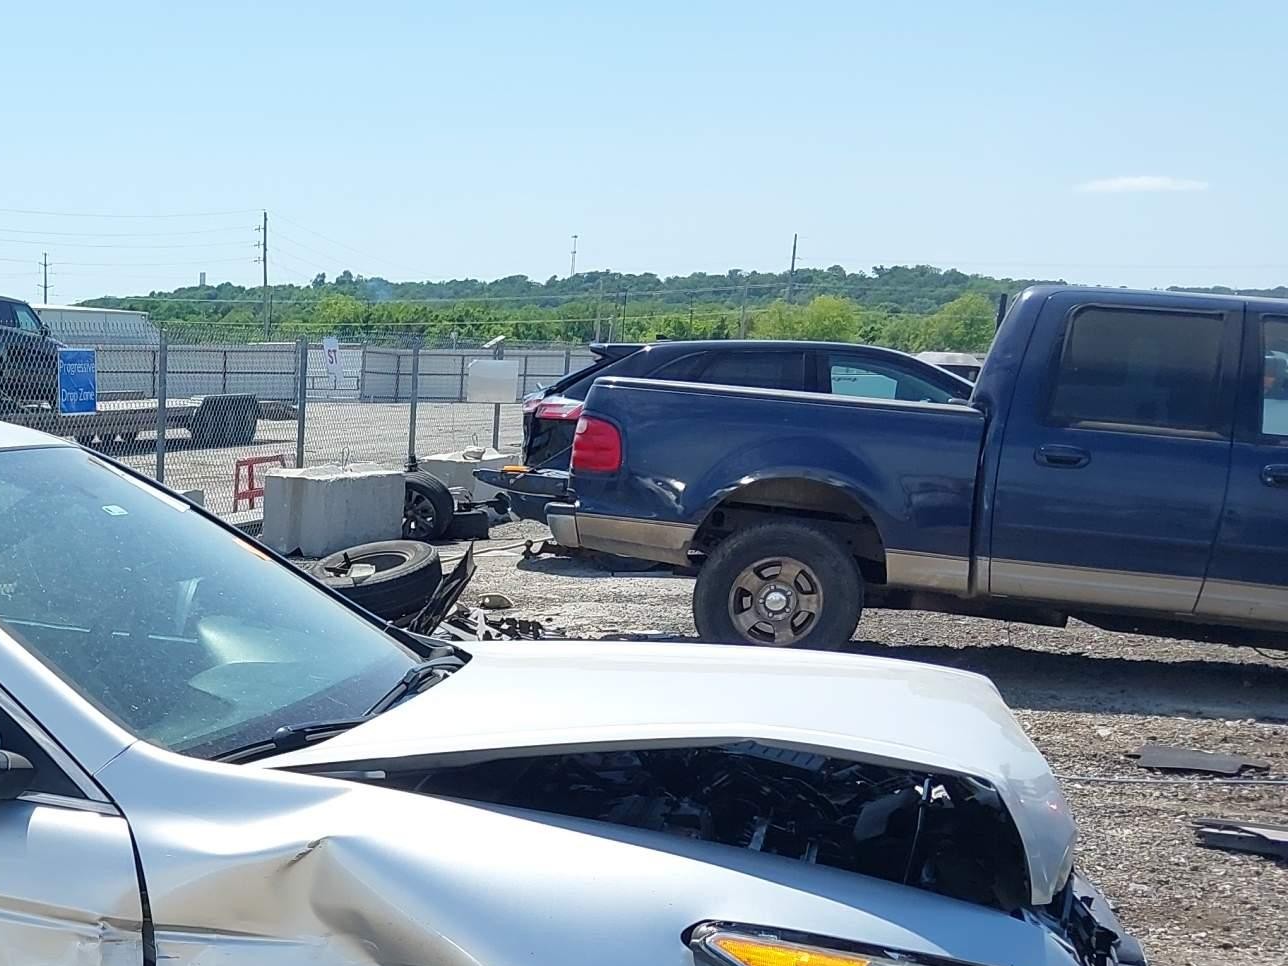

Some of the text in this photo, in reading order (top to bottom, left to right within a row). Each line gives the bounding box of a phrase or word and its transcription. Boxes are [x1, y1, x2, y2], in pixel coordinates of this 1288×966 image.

[59, 360, 95, 375] Progressive
[62, 388, 94, 404] Drop Zone
